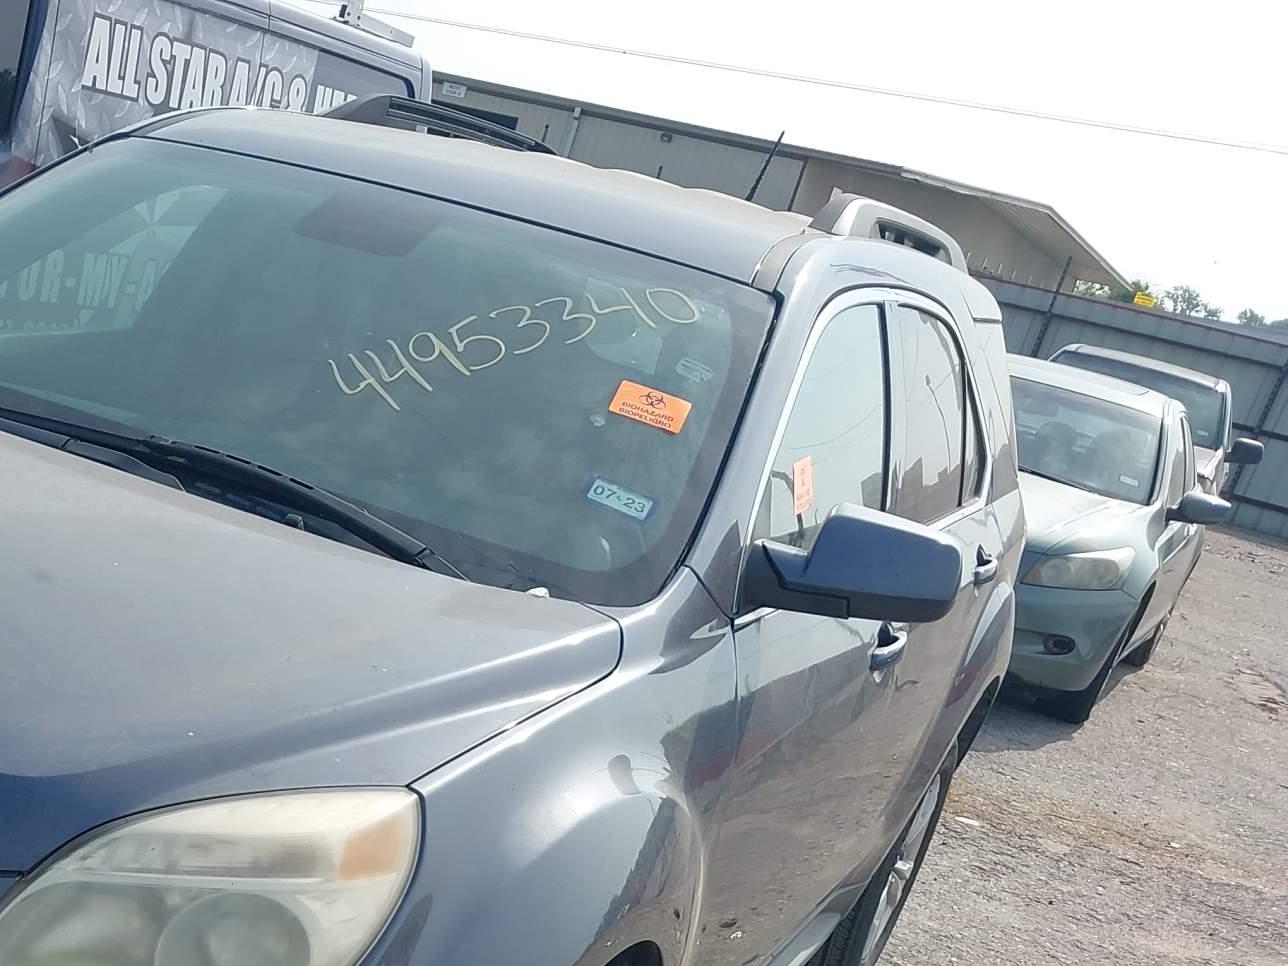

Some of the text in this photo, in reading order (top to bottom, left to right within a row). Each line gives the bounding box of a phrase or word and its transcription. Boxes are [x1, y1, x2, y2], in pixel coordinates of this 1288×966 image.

[81, 12, 145, 102] ALL
[145, 33, 227, 110] STAR
[328, 287, 701, 412] 44953340
[618, 406, 672, 430] BIOPELIGRO
[621, 400, 674, 422] BIOHAZARD
